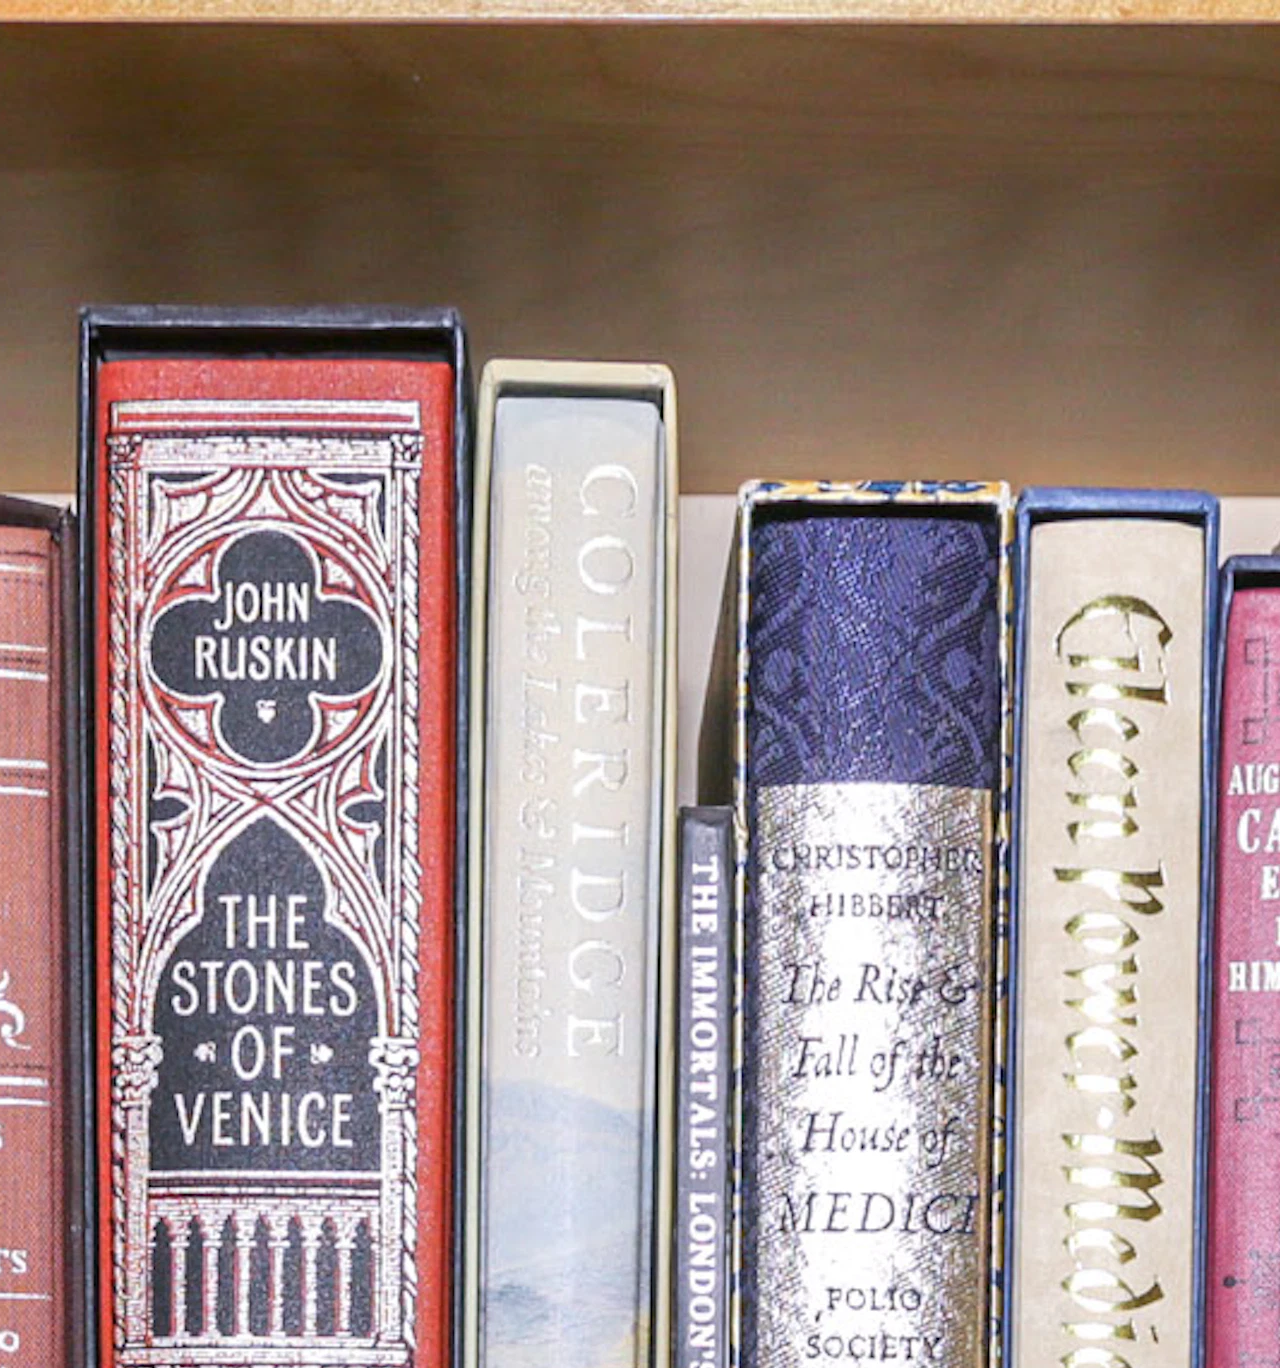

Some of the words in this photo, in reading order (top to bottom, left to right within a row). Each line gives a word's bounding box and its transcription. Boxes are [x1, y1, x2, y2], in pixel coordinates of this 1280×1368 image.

[215, 582, 309, 630] JOHN
[194, 638, 337, 681] RUSKIN
[566, 463, 640, 1058] COLERIDGE
[772, 845, 983, 873] CHRISTOPHER
[691, 855, 718, 934] THE
[809, 894, 944, 920] HIBBERT
[219, 895, 308, 951] THE
[170, 961, 359, 1016] STONES
[231, 1026, 295, 1081] OF
[690, 947, 718, 1181] IMMORTALS:
[794, 1036, 857, 1079] Fall
[174, 1092, 354, 1147] VENICE
[799, 1113, 910, 1154] House
[779, 1193, 978, 1235] MEDICI
[827, 1287, 922, 1312] FOLIO
[808, 1336, 944, 1361] SOCIETY
